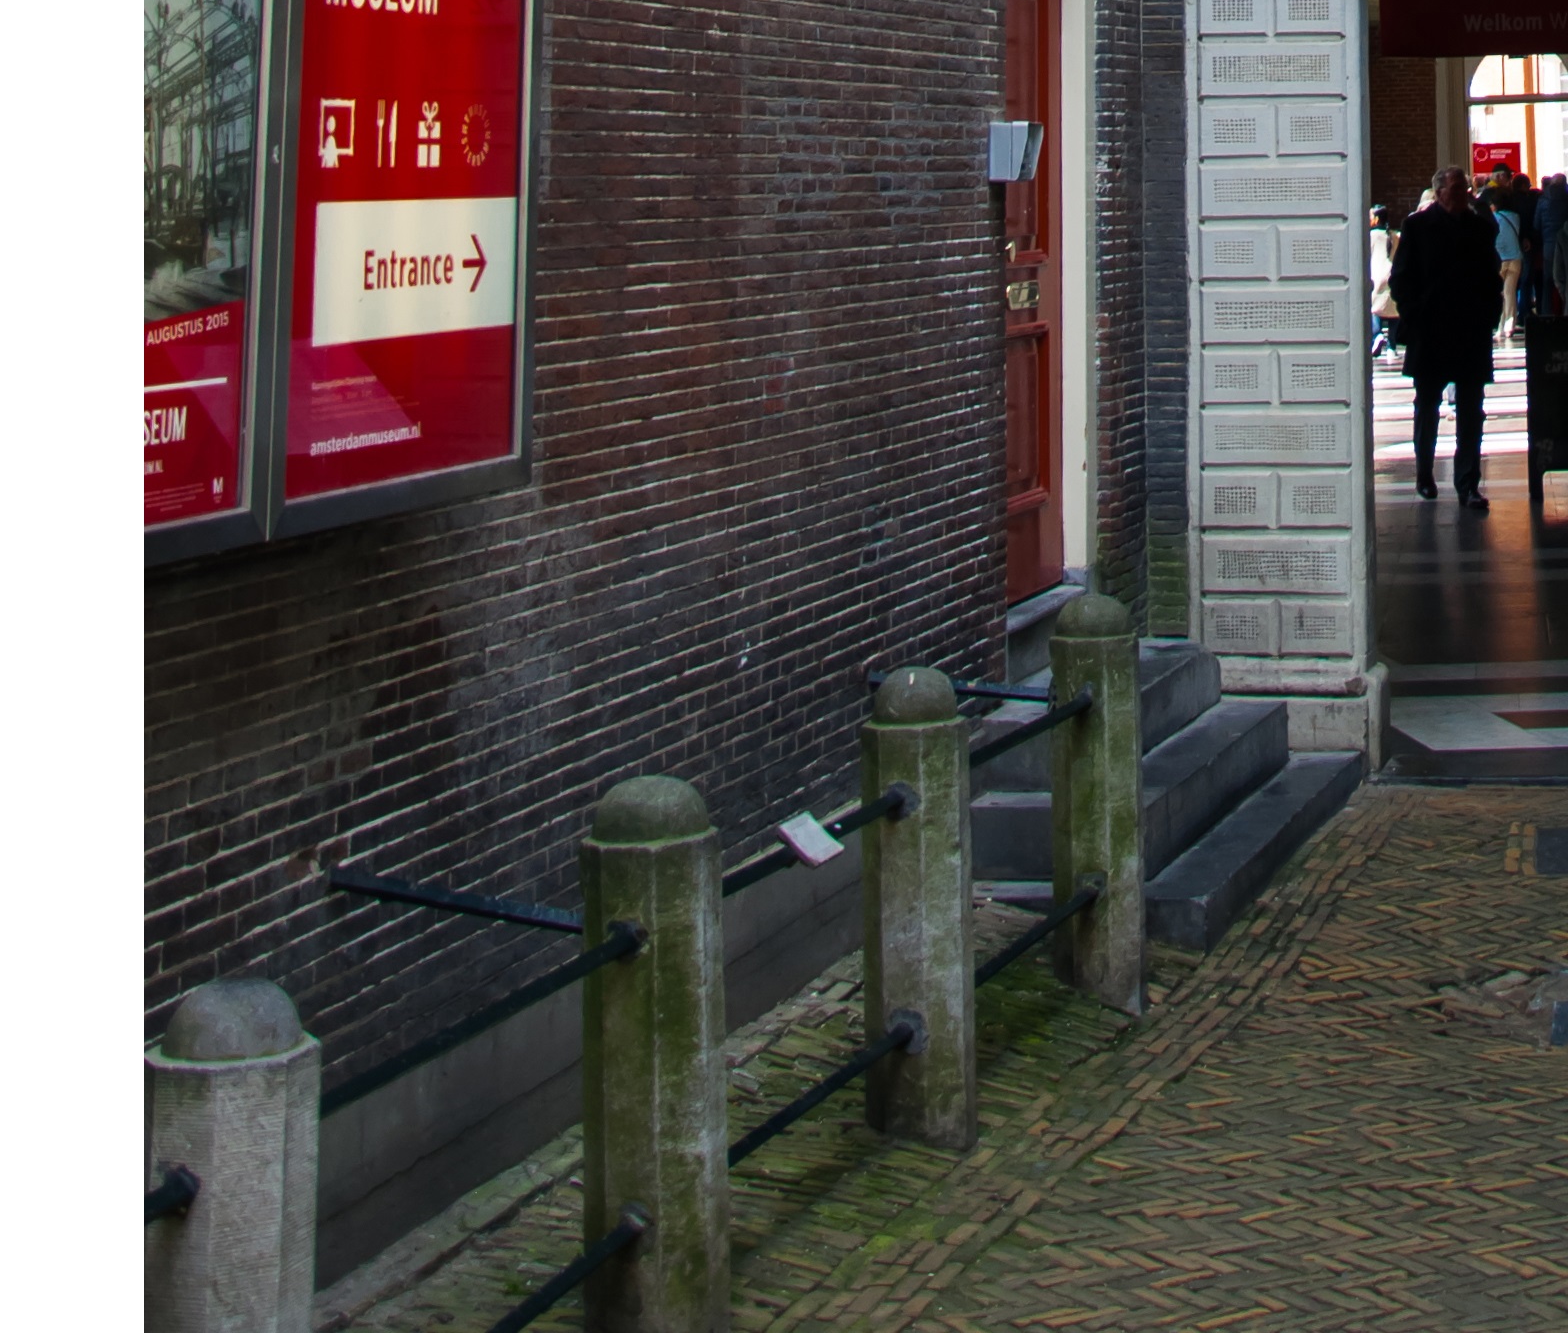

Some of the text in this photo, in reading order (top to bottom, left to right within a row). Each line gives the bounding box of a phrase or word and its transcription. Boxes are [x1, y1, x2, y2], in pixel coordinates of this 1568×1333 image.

[1463, 13, 1543, 32] Welkom
[363, 247, 454, 291] Entrance
[146, 310, 230, 346] AUGUSTUS 2015
[310, 420, 422, 457] amsterdammuseum.nl
